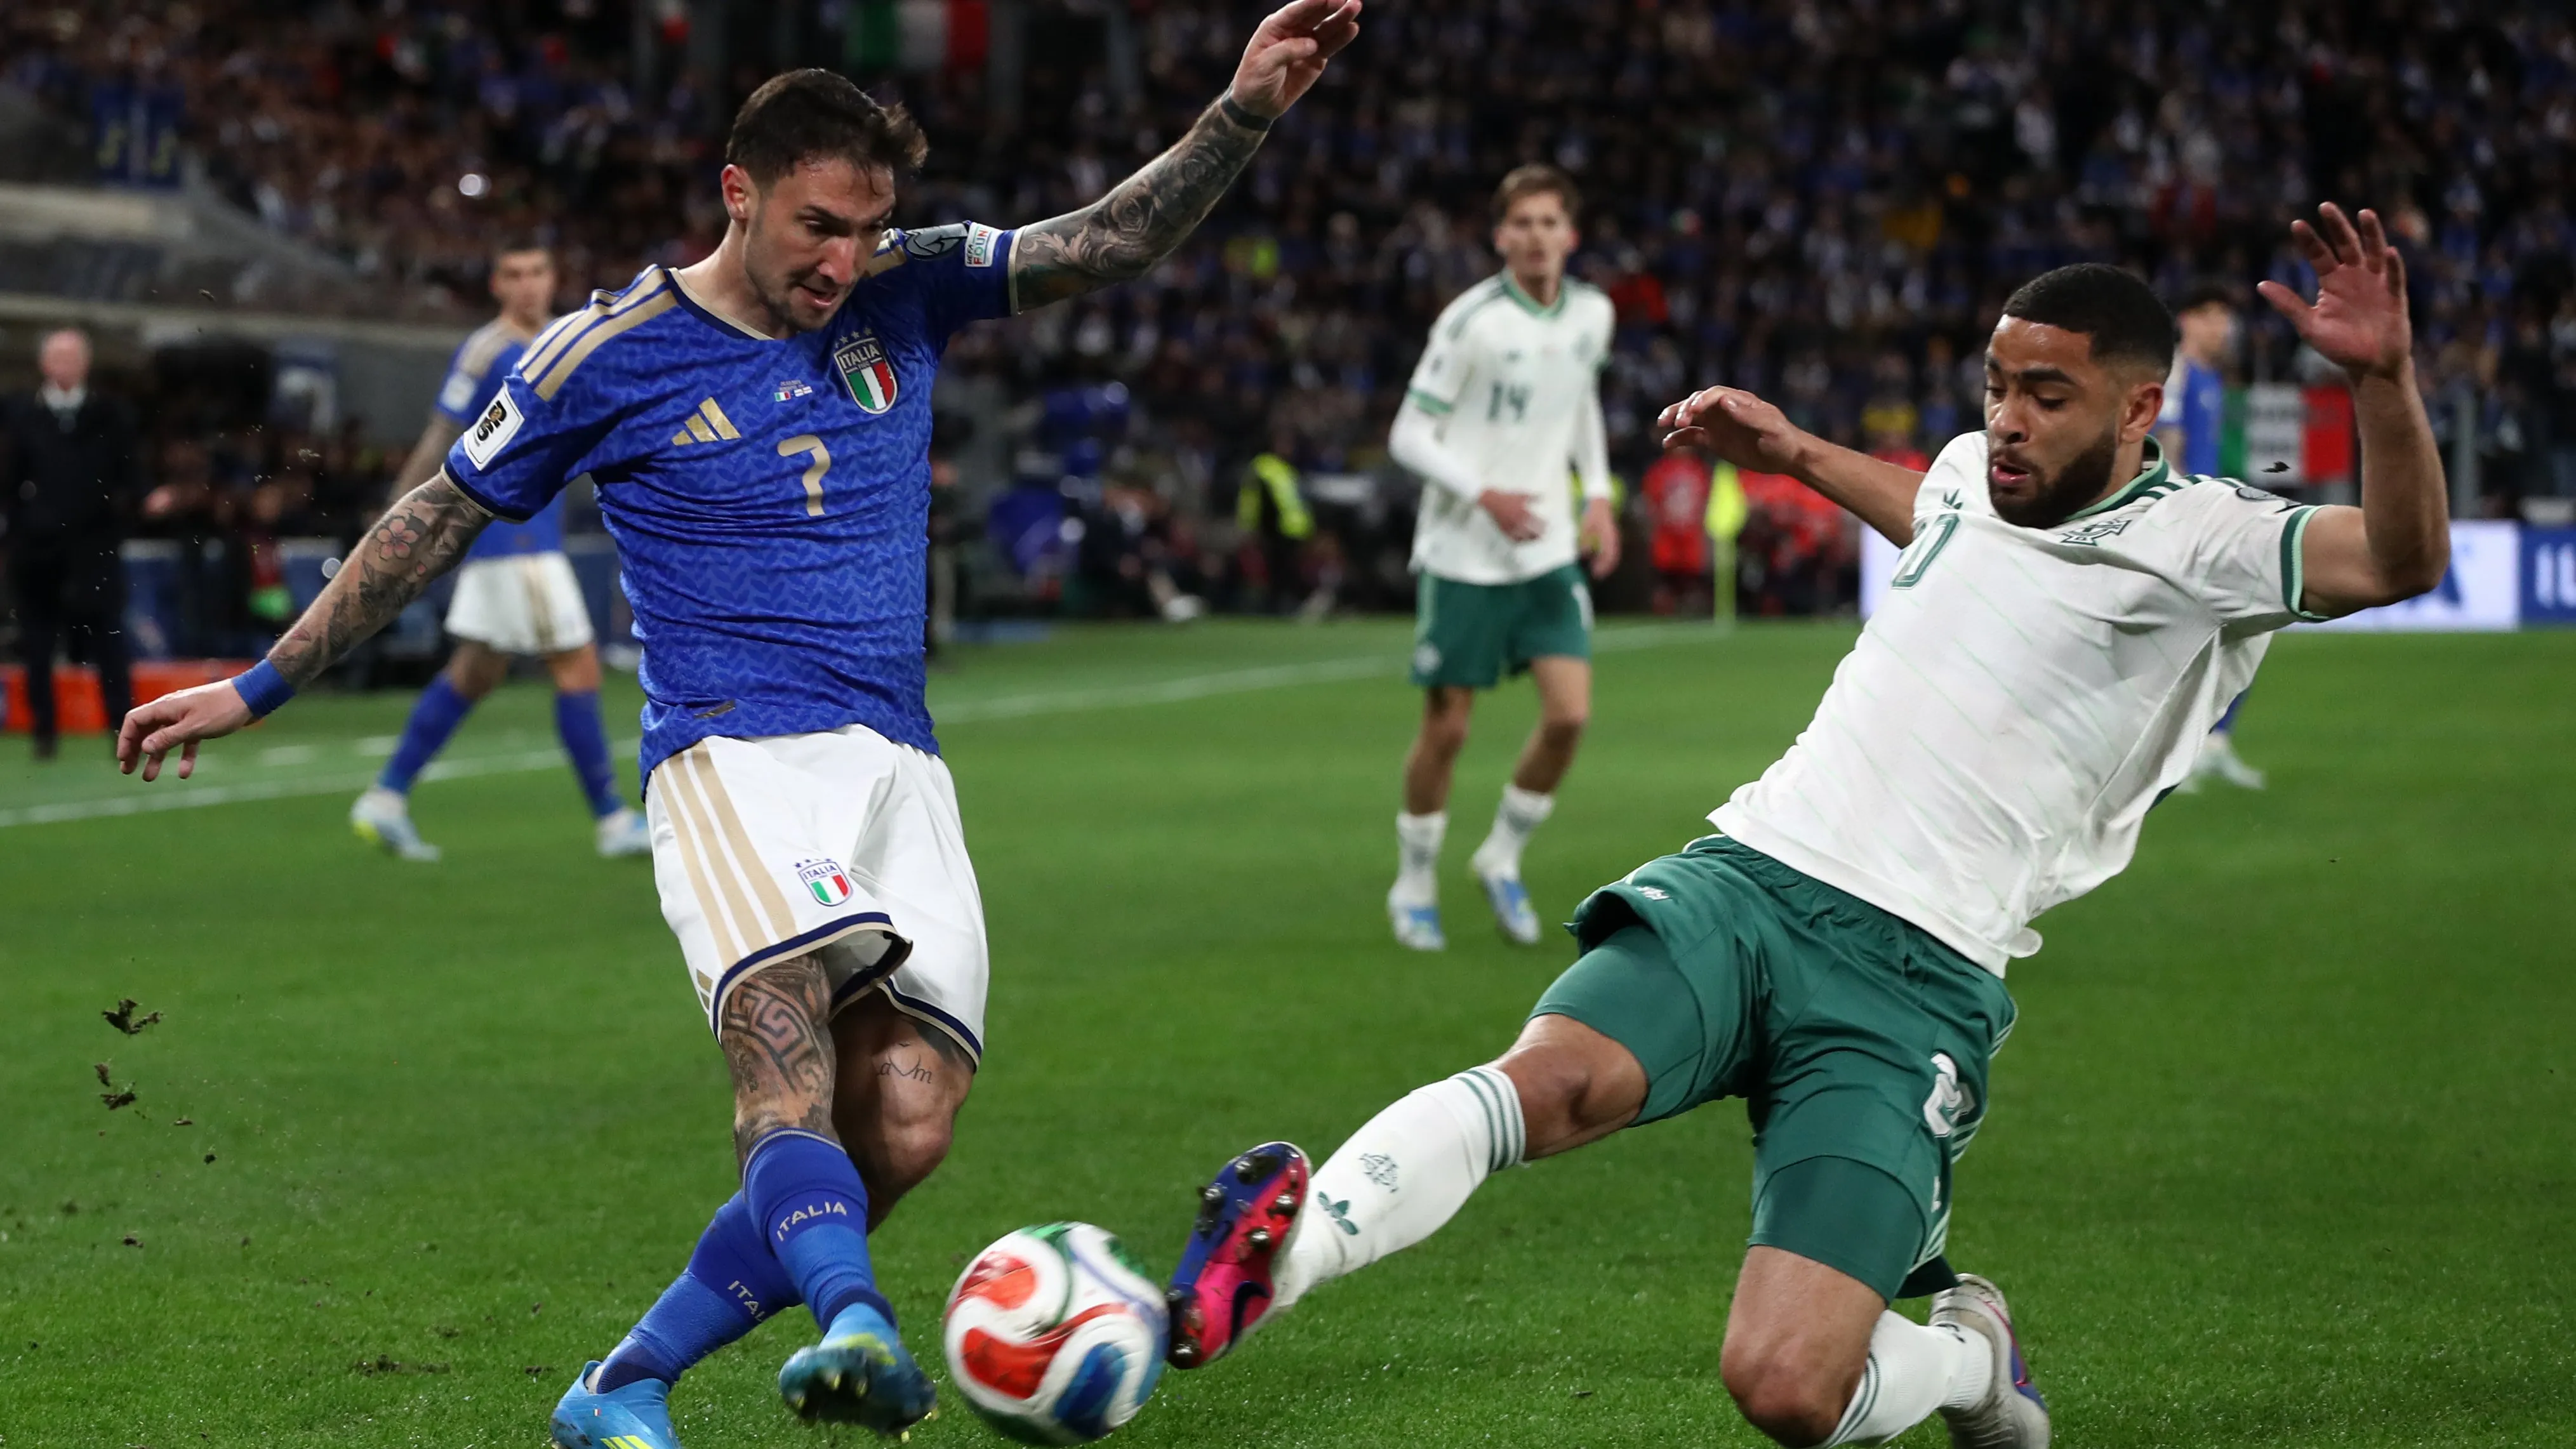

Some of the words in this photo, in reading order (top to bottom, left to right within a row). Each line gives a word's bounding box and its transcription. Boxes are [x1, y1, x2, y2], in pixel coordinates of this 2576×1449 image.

[973, 230, 988, 265] FOUN
[838, 343, 880, 368] ITALIA
[1489, 381, 1531, 421] 14
[777, 434, 831, 517] 7
[802, 864, 837, 880] ITALIA
[776, 1201, 847, 1241] ITALIA
